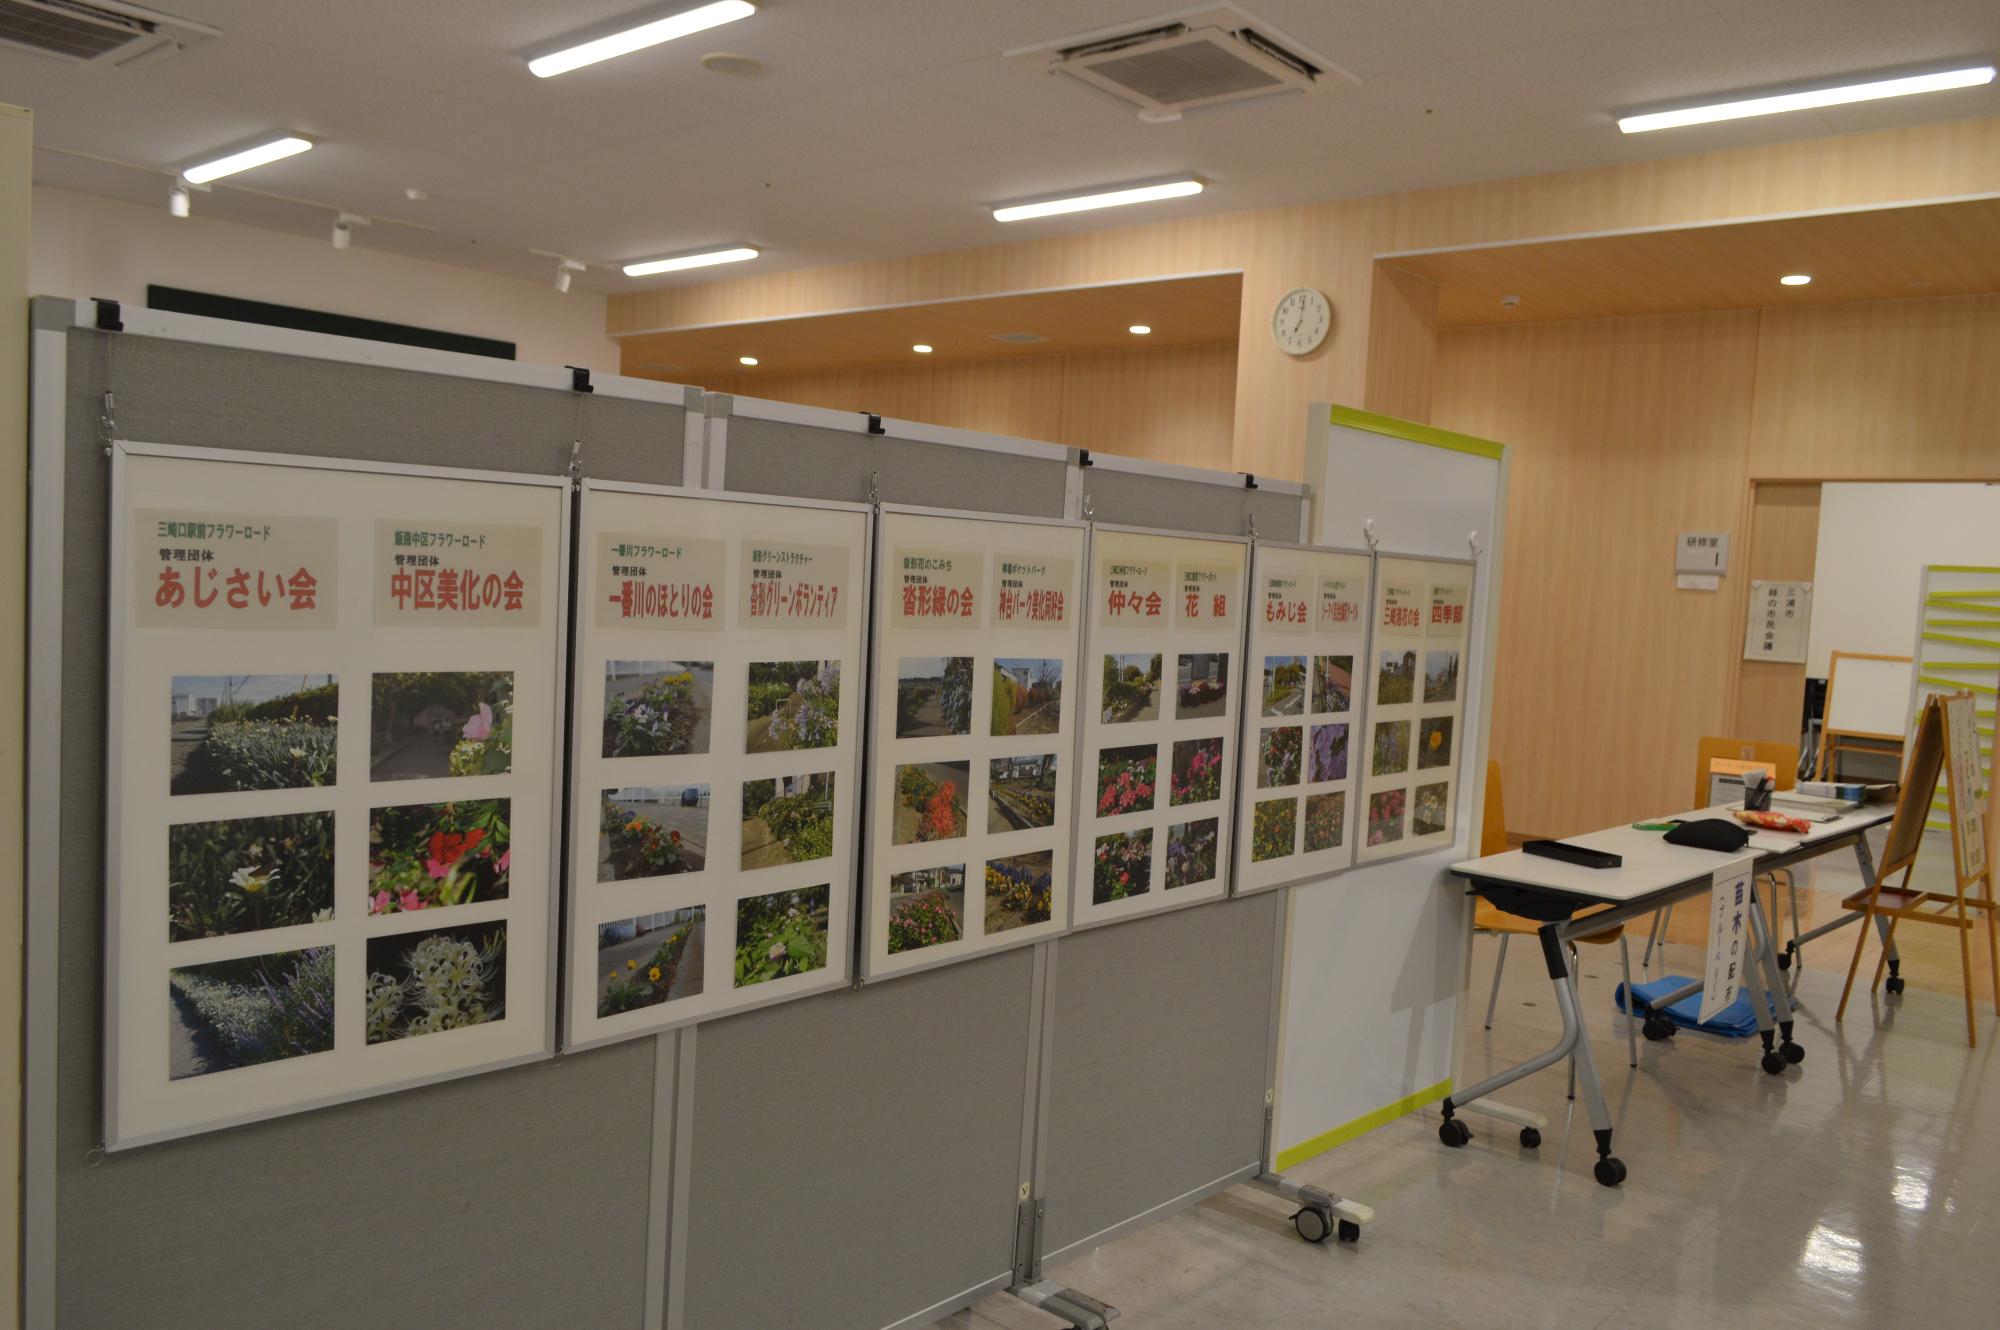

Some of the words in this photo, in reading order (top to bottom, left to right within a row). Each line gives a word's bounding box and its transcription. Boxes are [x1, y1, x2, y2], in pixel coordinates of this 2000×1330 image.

[1686, 536, 1719, 548] 研修室
[158, 547, 215, 563] 管理団体
[394, 553, 440, 568] 管理団体
[611, 565, 648, 577] 管理団体
[752, 568, 783, 579] 管理団体
[154, 566, 317, 610] あじさい会
[390, 566, 525, 611] 中区美化の会
[608, 580, 715, 620] 一番川のほとりの会
[1107, 590, 1163, 617] 仲々会
[1265, 600, 1308, 625] もみじ会
